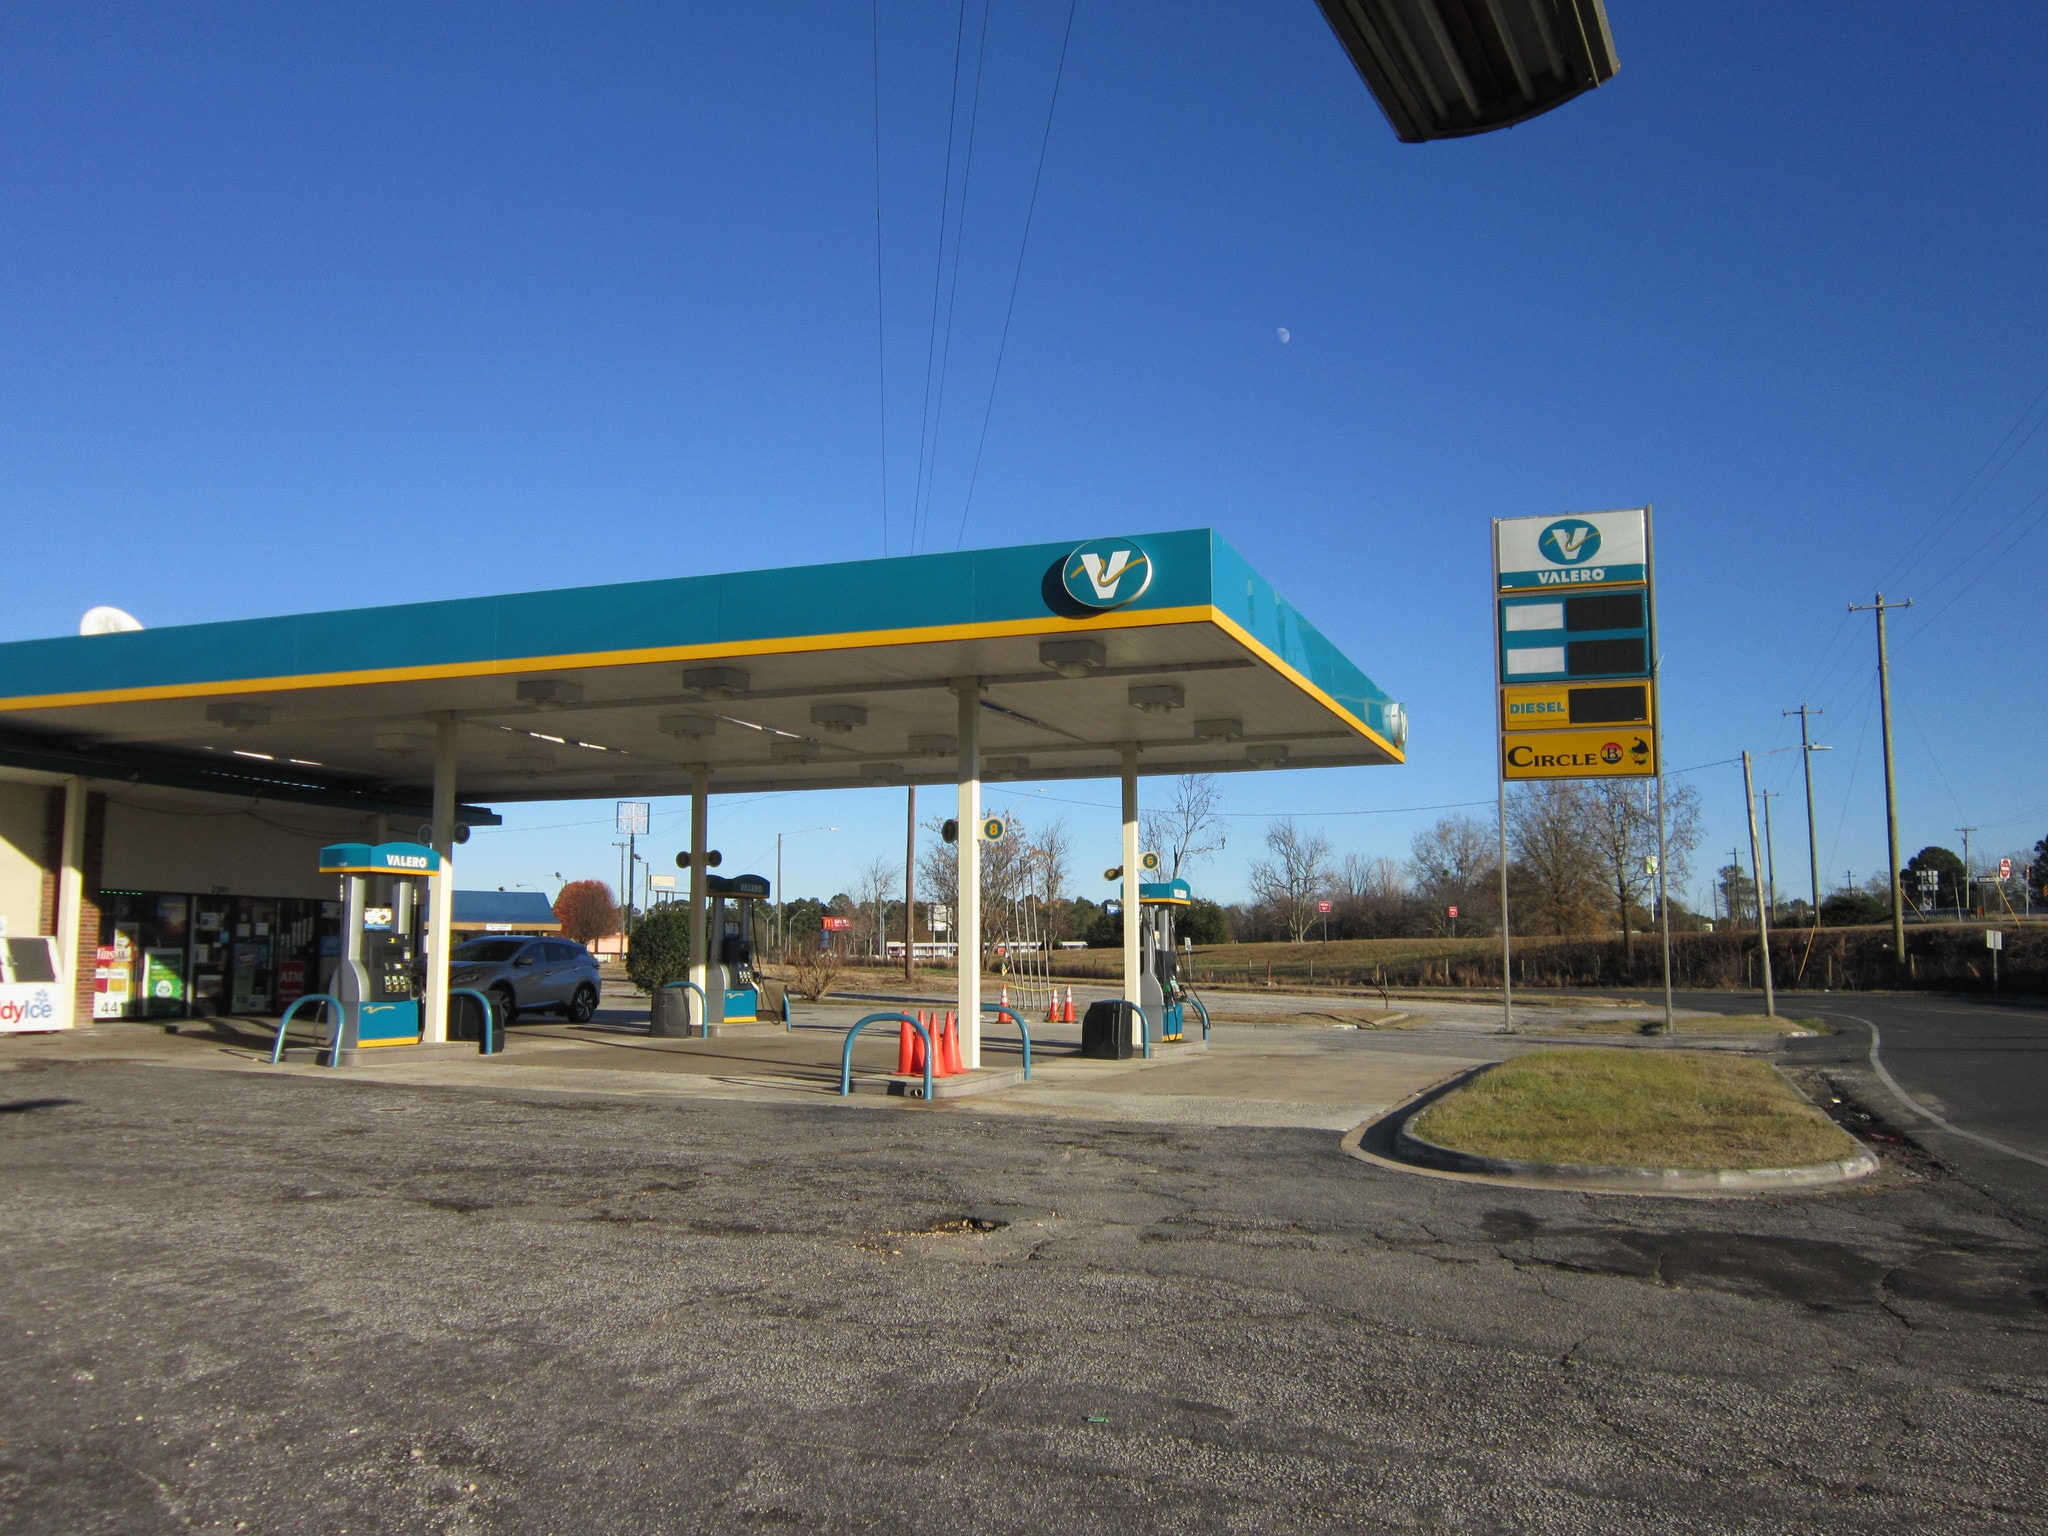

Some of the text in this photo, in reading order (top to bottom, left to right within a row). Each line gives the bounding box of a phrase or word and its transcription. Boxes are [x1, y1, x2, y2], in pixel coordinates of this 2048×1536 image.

[1537, 568, 1603, 584] VALERO
[1510, 701, 1565, 714] DIESEL
[1605, 747, 1618, 759] B
[989, 823, 998, 835] 8
[386, 854, 427, 868] VALERO
[1146, 857, 1153, 866] 6
[740, 883, 762, 893] VALERO
[280, 971, 303, 983] ATM
